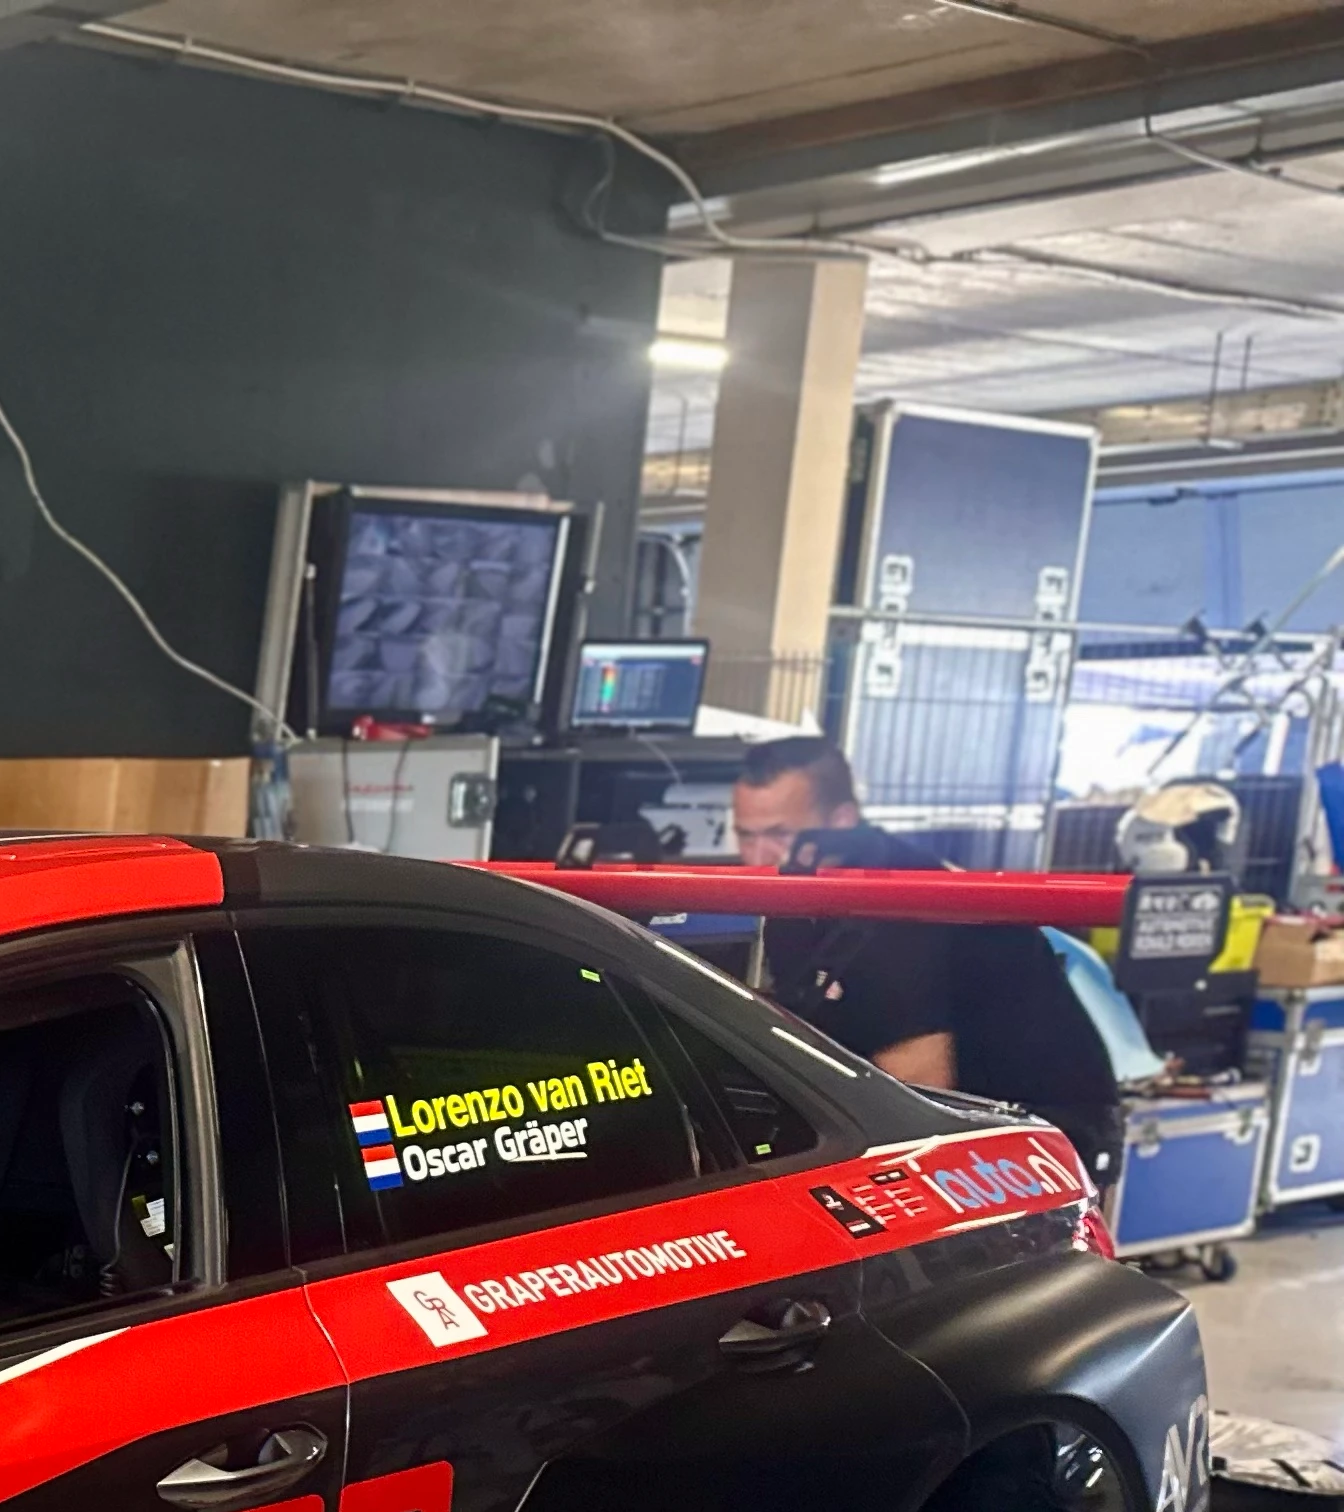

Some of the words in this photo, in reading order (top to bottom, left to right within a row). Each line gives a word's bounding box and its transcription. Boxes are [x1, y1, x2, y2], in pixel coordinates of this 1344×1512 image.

[385, 1084, 524, 1137] Lorenzo
[528, 1074, 588, 1113] van
[587, 1058, 652, 1103] Riet
[402, 1137, 488, 1181] Oscar
[494, 1117, 587, 1161] Gräper
[463, 1230, 747, 1314] GRAPERAUTOMOTIVE
